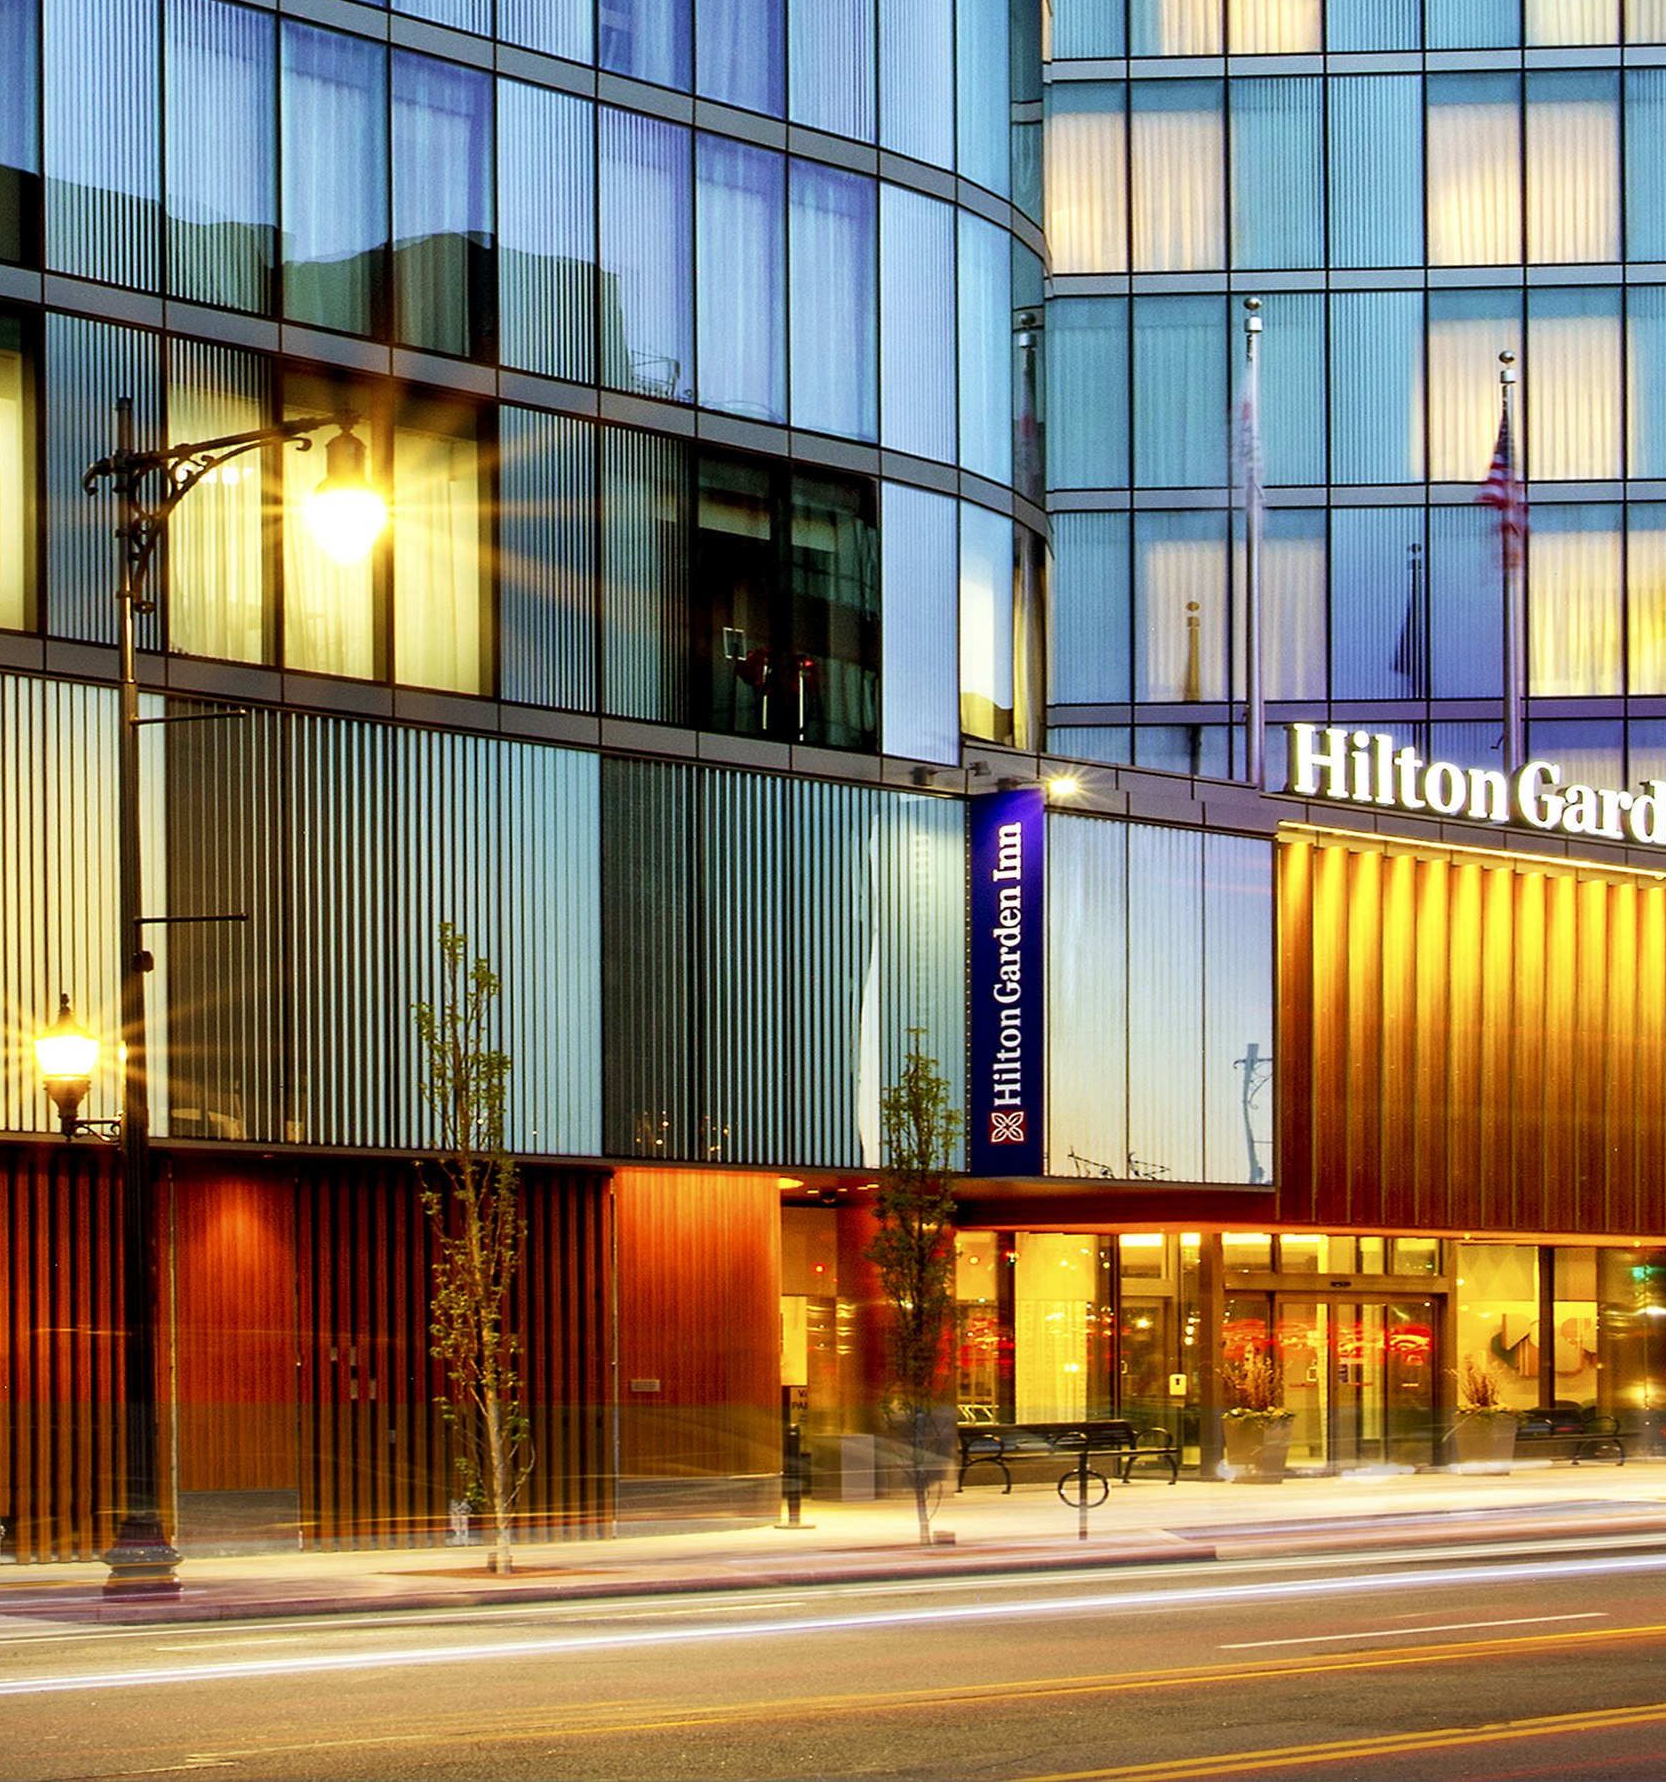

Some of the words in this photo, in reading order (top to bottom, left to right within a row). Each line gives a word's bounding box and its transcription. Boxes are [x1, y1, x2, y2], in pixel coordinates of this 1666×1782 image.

[1291, 723, 1510, 823] Hilton
[992, 821, 1022, 883] Inn
[992, 885, 1022, 1005] Garden
[992, 1007, 1022, 1106] Hilton
